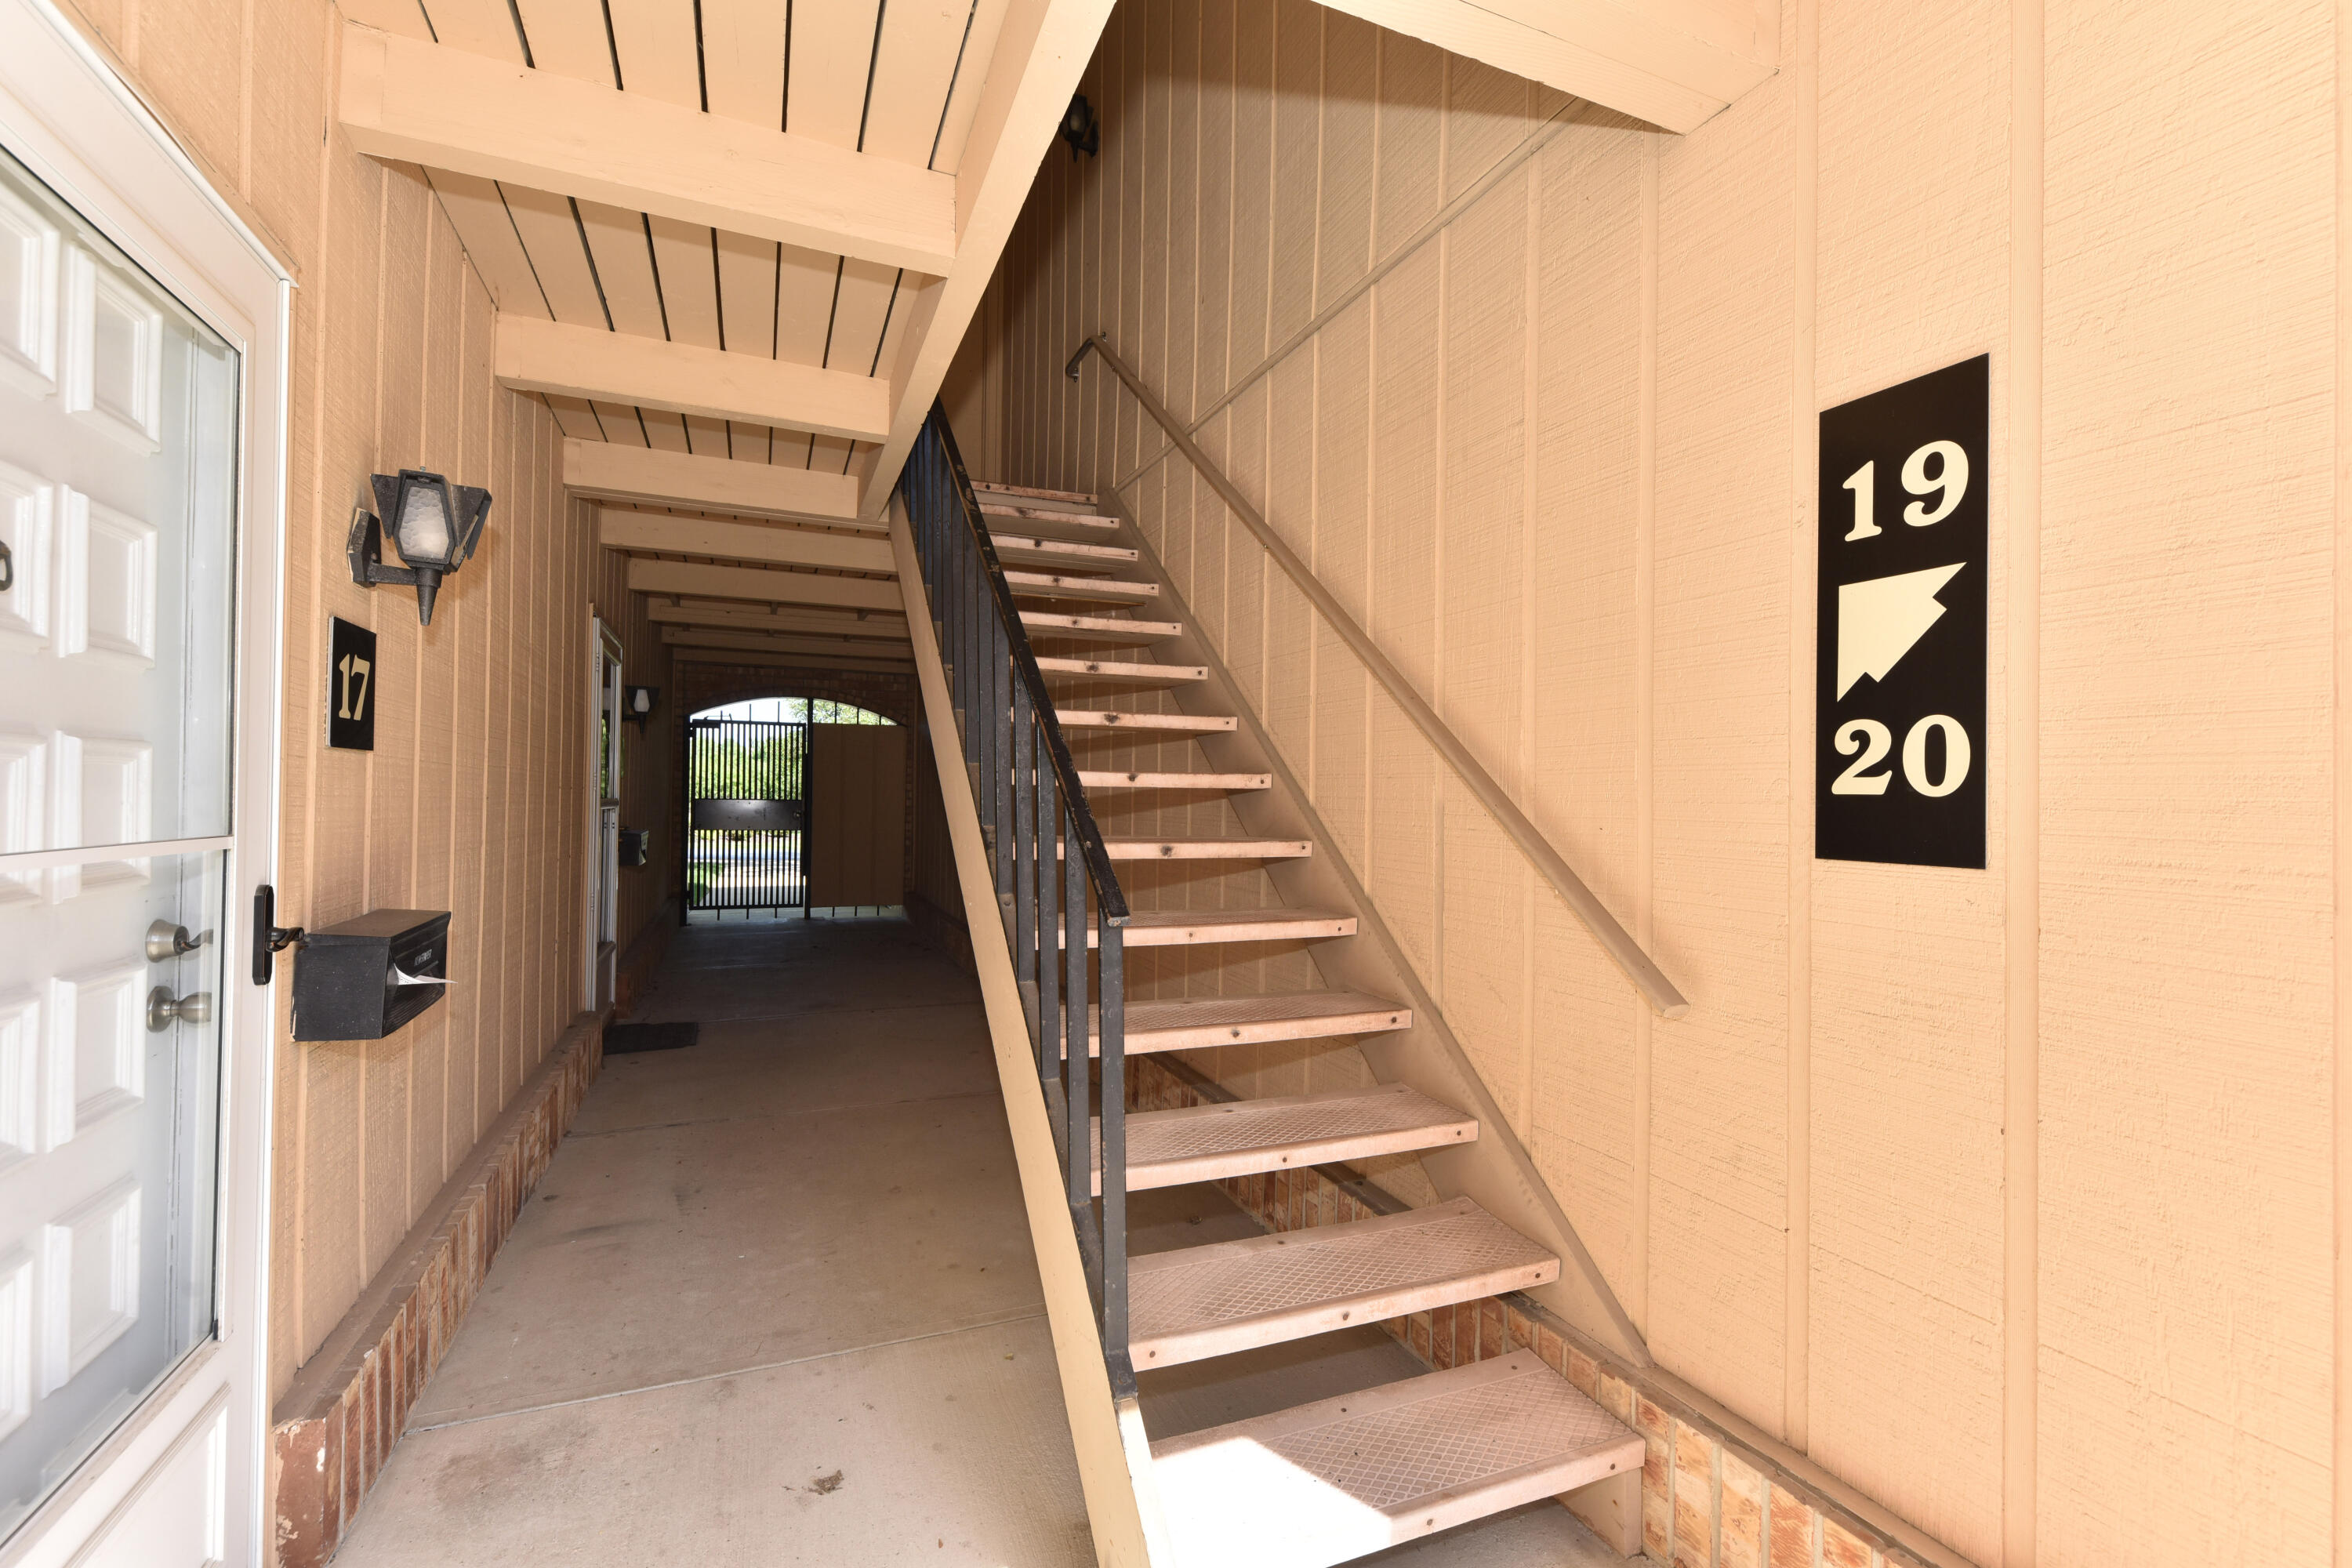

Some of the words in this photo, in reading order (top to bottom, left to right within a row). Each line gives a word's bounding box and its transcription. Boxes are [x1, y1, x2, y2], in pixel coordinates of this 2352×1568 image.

[1842, 440, 1969, 542] 19
[339, 653, 371, 721] 17
[1831, 713, 1971, 797] 20
